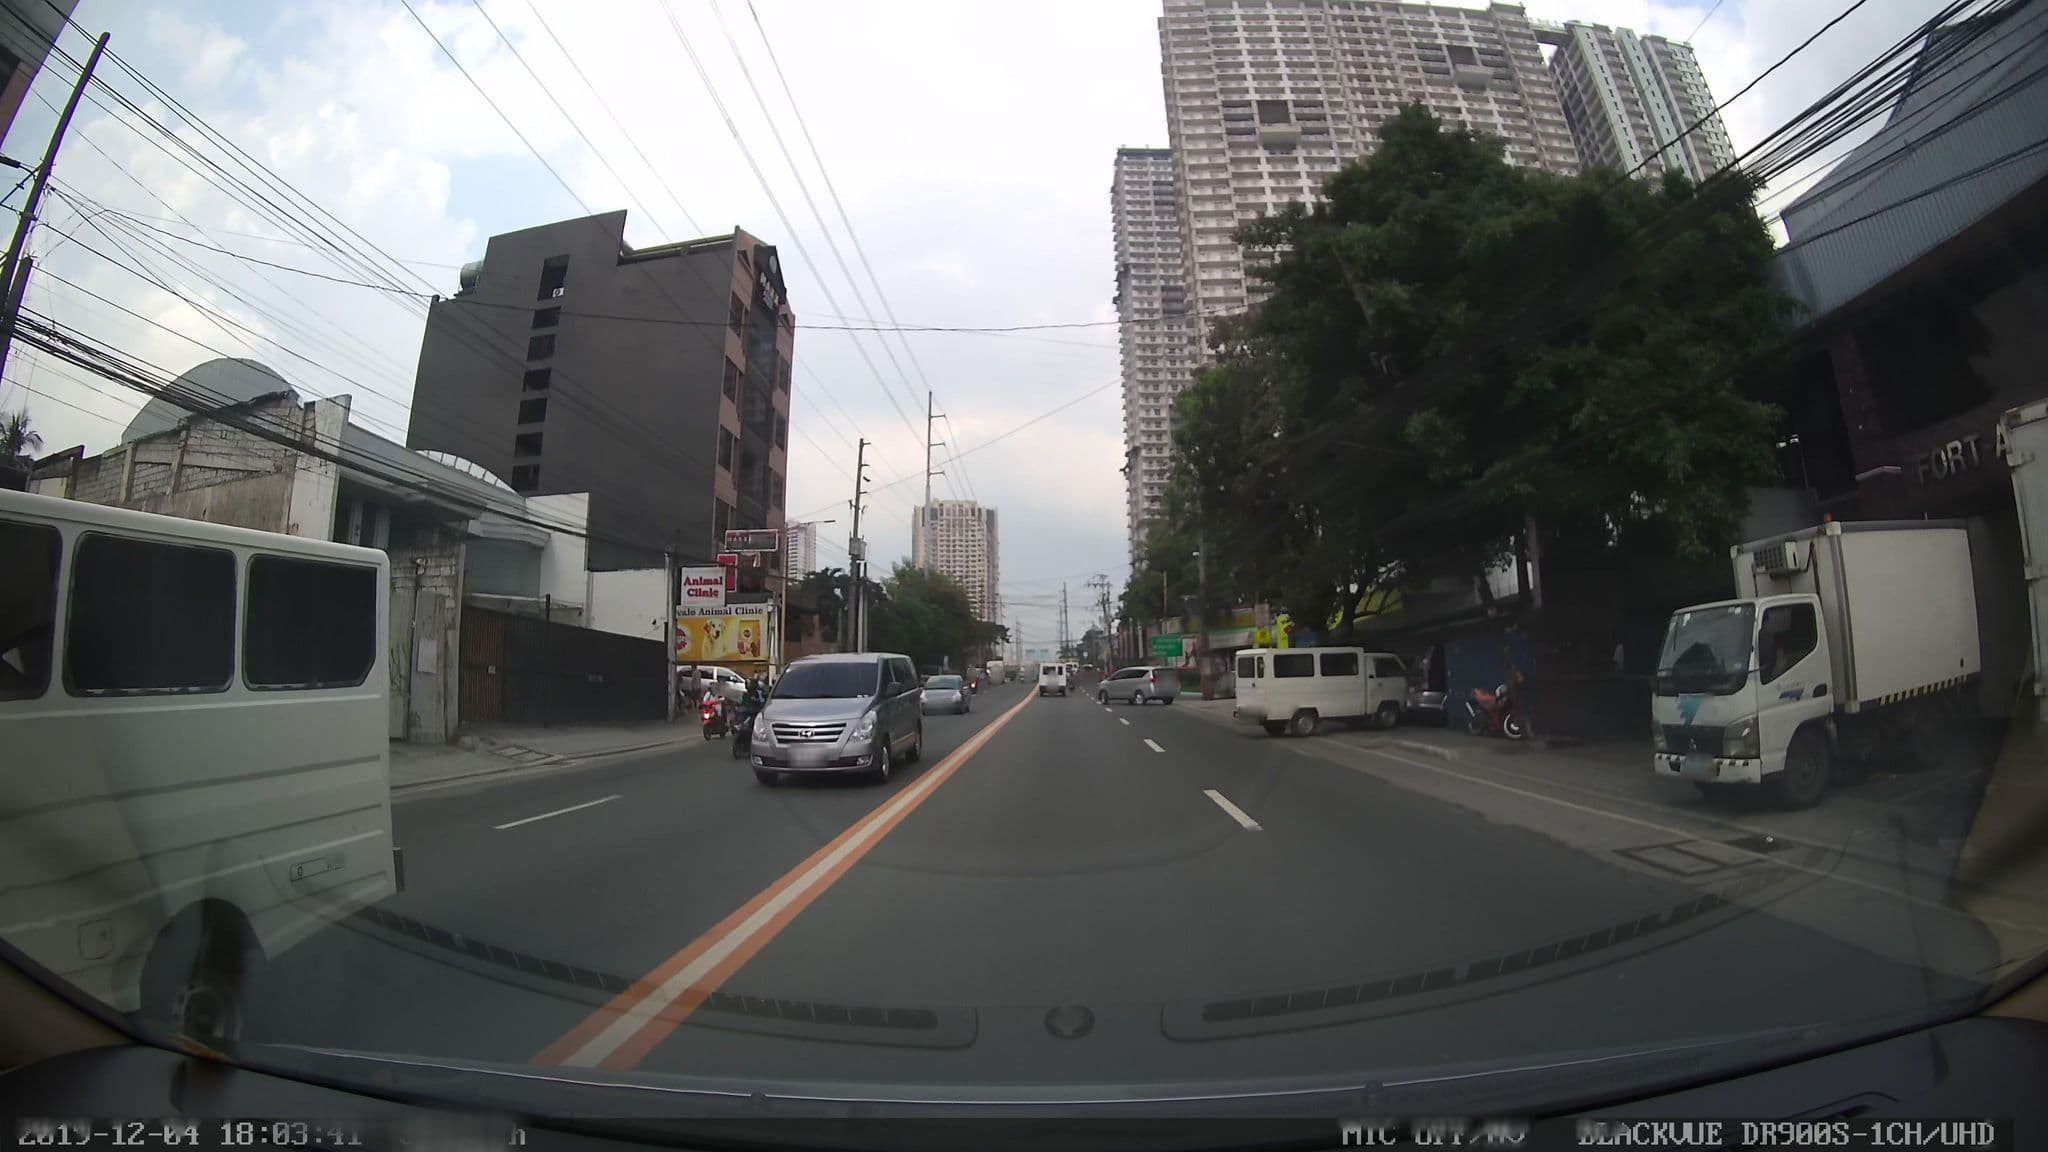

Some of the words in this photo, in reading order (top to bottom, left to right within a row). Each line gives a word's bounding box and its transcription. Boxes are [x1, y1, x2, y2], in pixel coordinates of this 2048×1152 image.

[1917, 433, 1982, 485] FORT
[683, 576, 723, 586] Animal
[687, 588, 719, 598] Clinic
[698, 606, 732, 616] Animal
[735, 606, 763, 616] Clinic
